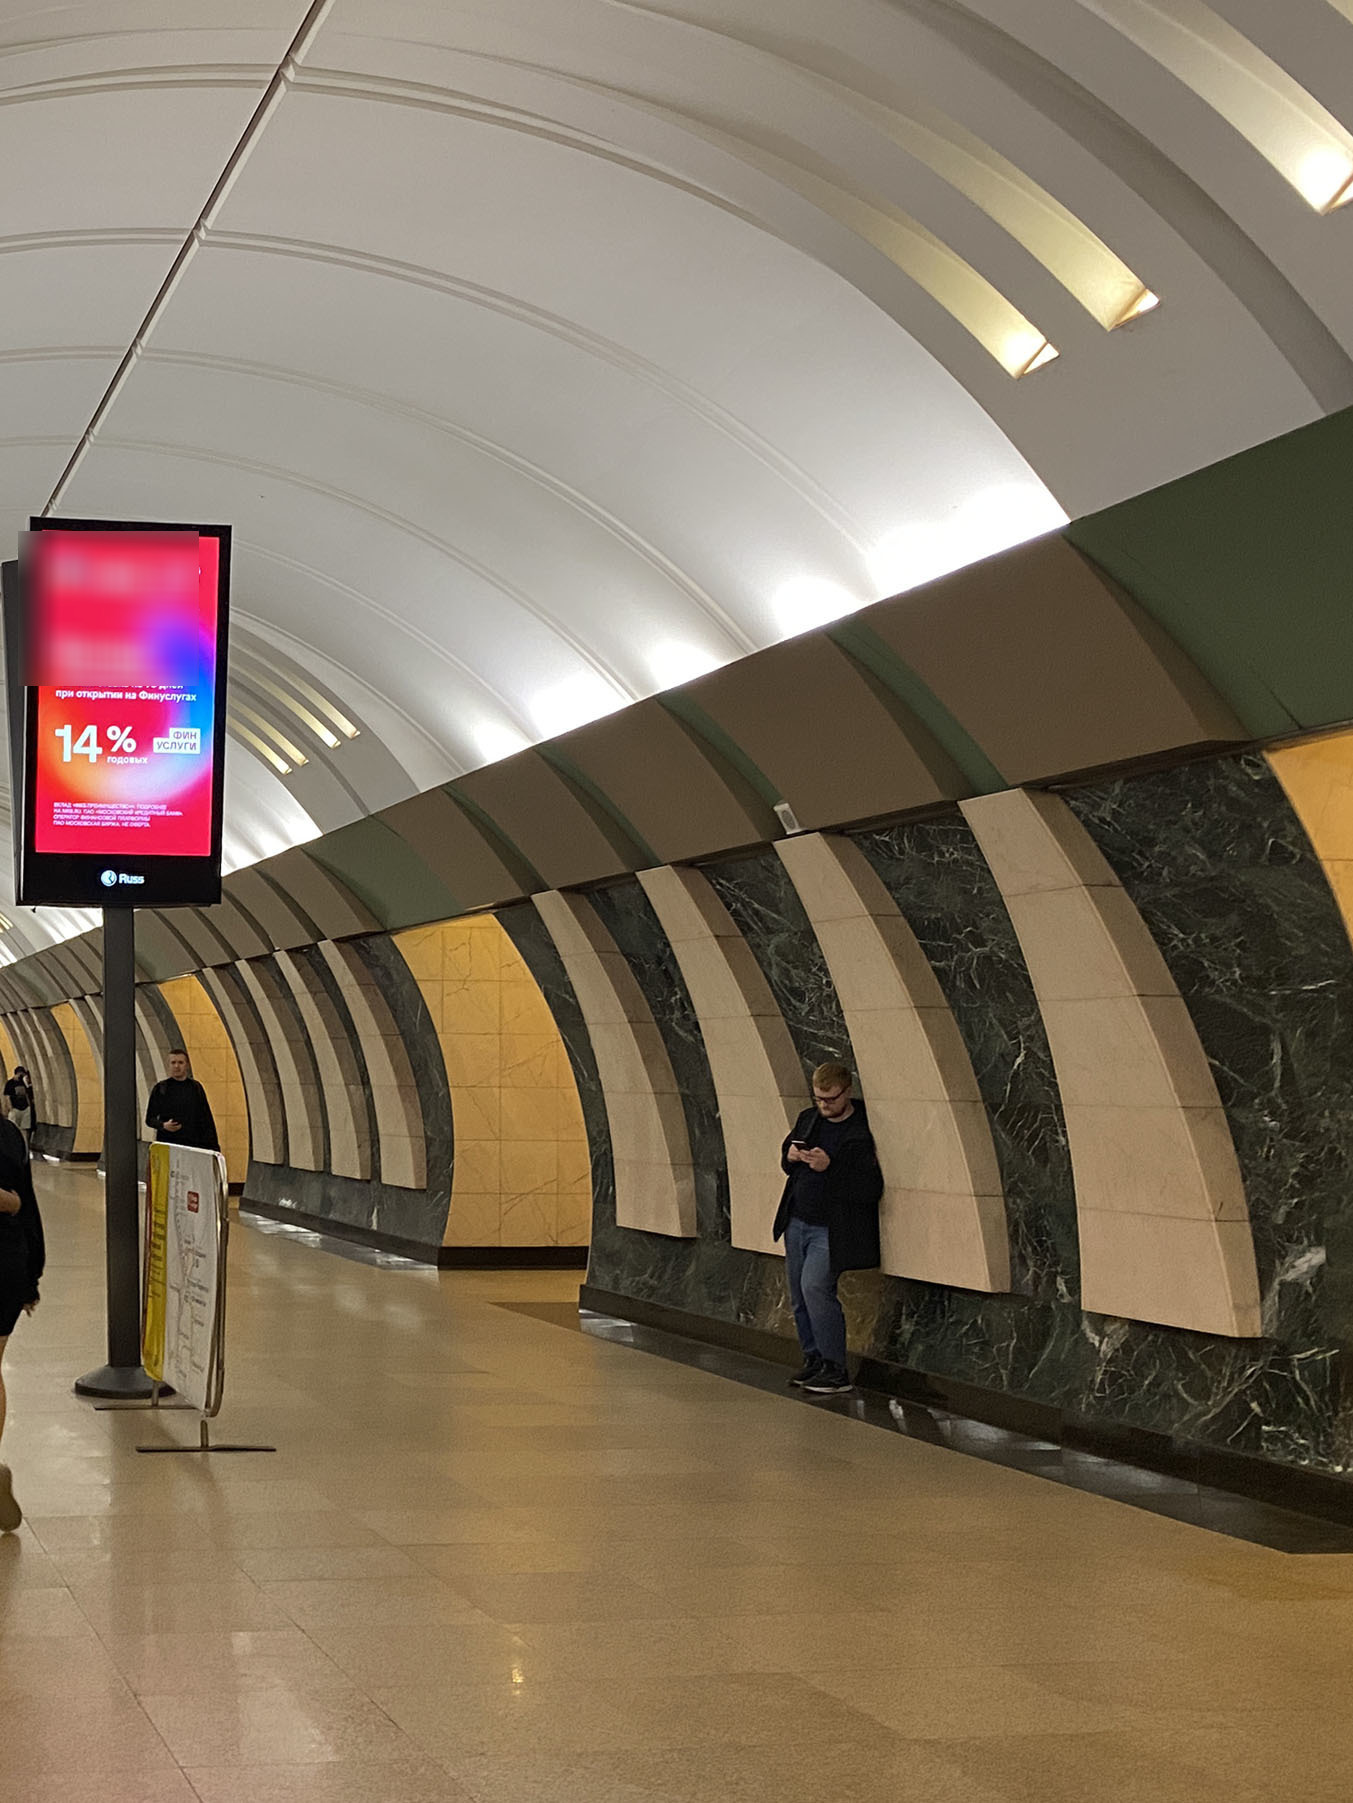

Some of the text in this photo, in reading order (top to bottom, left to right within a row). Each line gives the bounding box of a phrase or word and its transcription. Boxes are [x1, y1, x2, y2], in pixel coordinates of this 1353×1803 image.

[55, 690, 197, 703] при открытии на Финуслугах
[173, 730, 197, 740] ФИН
[156, 741, 197, 751] УСЛУГИ
[107, 756, 148, 766] годовых
[118, 873, 145, 884] Russ
